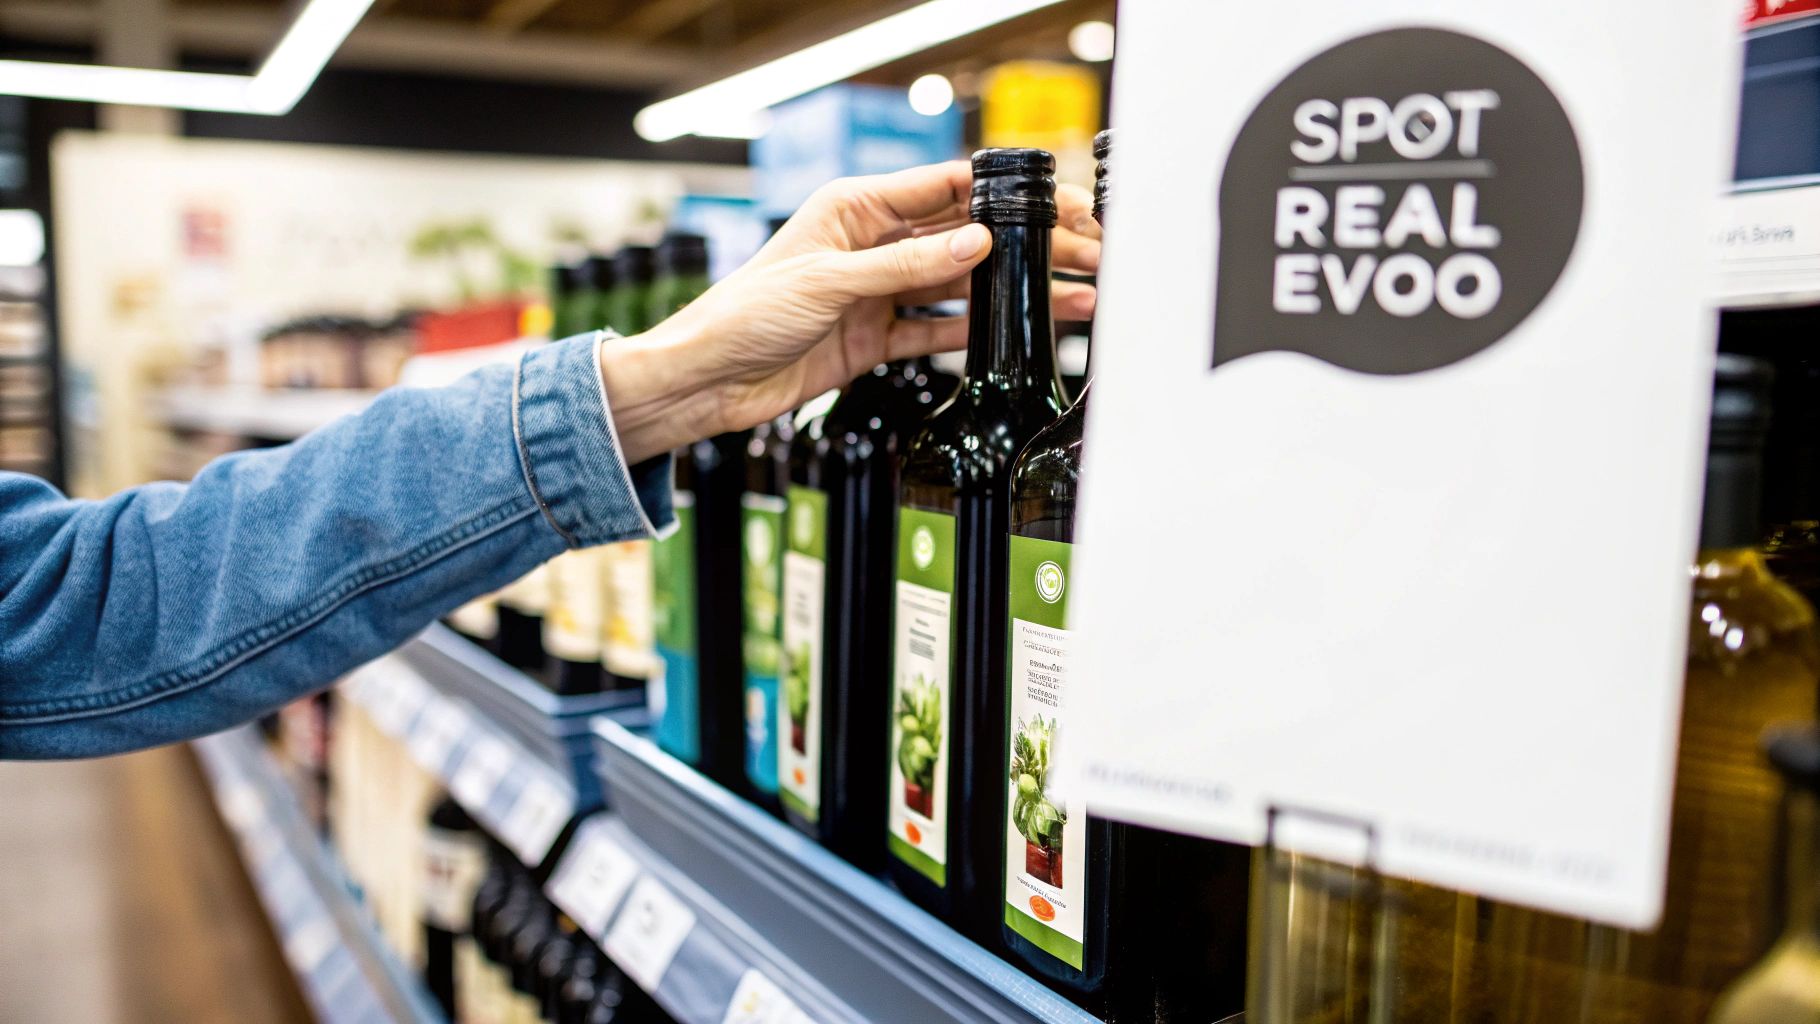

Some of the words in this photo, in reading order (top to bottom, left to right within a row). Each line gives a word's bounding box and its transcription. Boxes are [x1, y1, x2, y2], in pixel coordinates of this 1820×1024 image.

[1290, 89, 1500, 163] SPOT
[1275, 182, 1501, 249] REAL
[1273, 253, 1501, 319] EVOO
